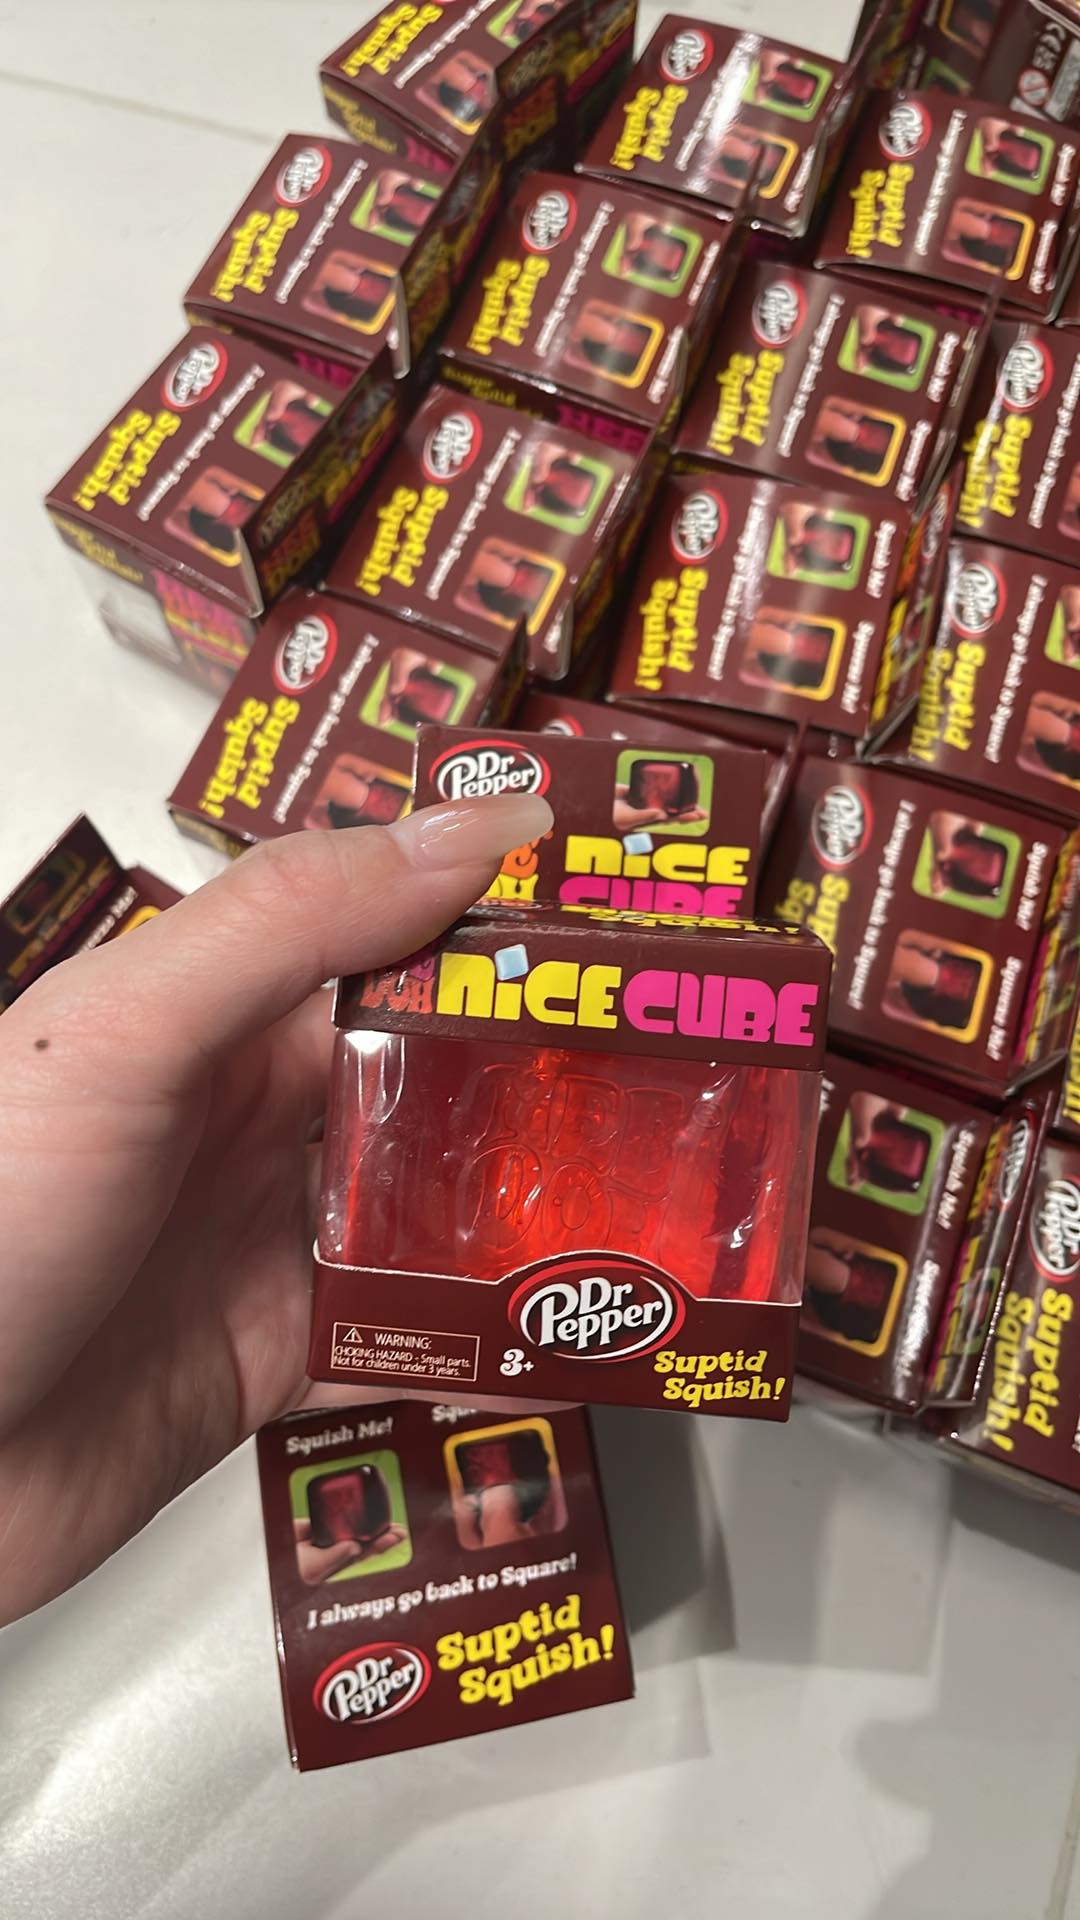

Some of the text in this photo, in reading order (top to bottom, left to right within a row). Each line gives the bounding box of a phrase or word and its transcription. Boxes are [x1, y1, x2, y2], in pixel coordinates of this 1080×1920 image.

[73, 409, 157, 511] Squish!
[106, 410, 182, 506] Suptid
[356, 487, 419, 597] Squish!
[389, 484, 449, 588] Suptid
[634, 579, 678, 691] Squish!
[663, 567, 709, 673] Suptid
[939, 640, 987, 751] Suptid
[198, 697, 269, 818] Squish!
[233, 695, 301, 810] Suptid
[478, 750, 514, 776] Dr
[623, 968, 819, 1048] CUBE
[538, 1277, 664, 1350] Pepper
[579, 1276, 633, 1304] Dr
[334, 1346, 375, 1359] CHOKING
[376, 1349, 413, 1362] HAZARD
[421, 1353, 446, 1366] Small
[447, 1357, 471, 1369] parts.
[334, 1355, 461, 1378] Not for children under 3 years.
[374, 1332, 432, 1350] WARNING:
[500, 1348, 535, 1378] 3+
[652, 1351, 768, 1381] Suptid
[987, 1292, 1036, 1452] Squish!
[1023, 1287, 1074, 1437] Suptid
[663, 1376, 786, 1407] Squish!
[286, 1416, 394, 1455] Squish Me!
[306, 1552, 577, 1630] I always go back to Square!
[435, 1594, 582, 1671] Suptid
[458, 1624, 614, 1705] Squish!
[331, 1664, 416, 1721] Pepper
